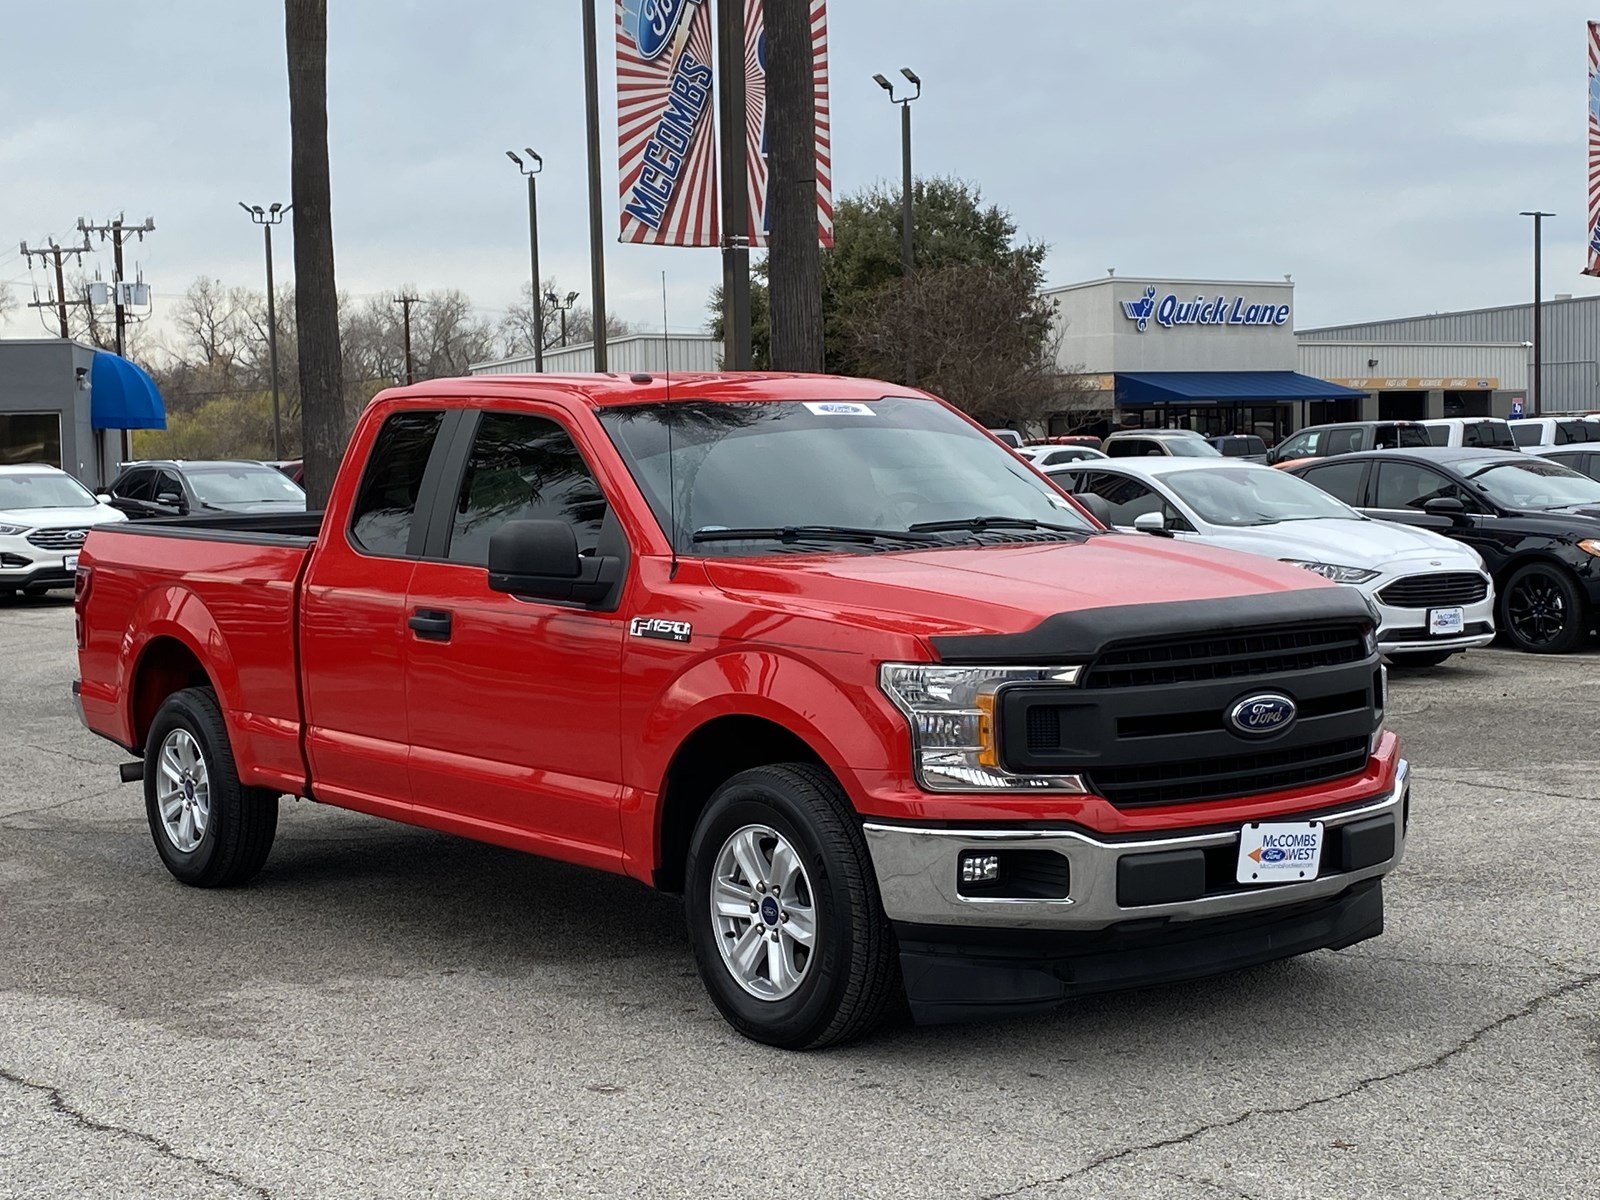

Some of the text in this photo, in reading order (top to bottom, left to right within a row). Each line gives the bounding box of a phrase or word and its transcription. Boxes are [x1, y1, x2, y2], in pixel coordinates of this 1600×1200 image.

[1157, 294, 1290, 327] Quick Lane
[1249, 703, 1282, 725] Ford
[1263, 834, 1316, 847] McCOMBS
[1265, 848, 1316, 860] Ford WEST
